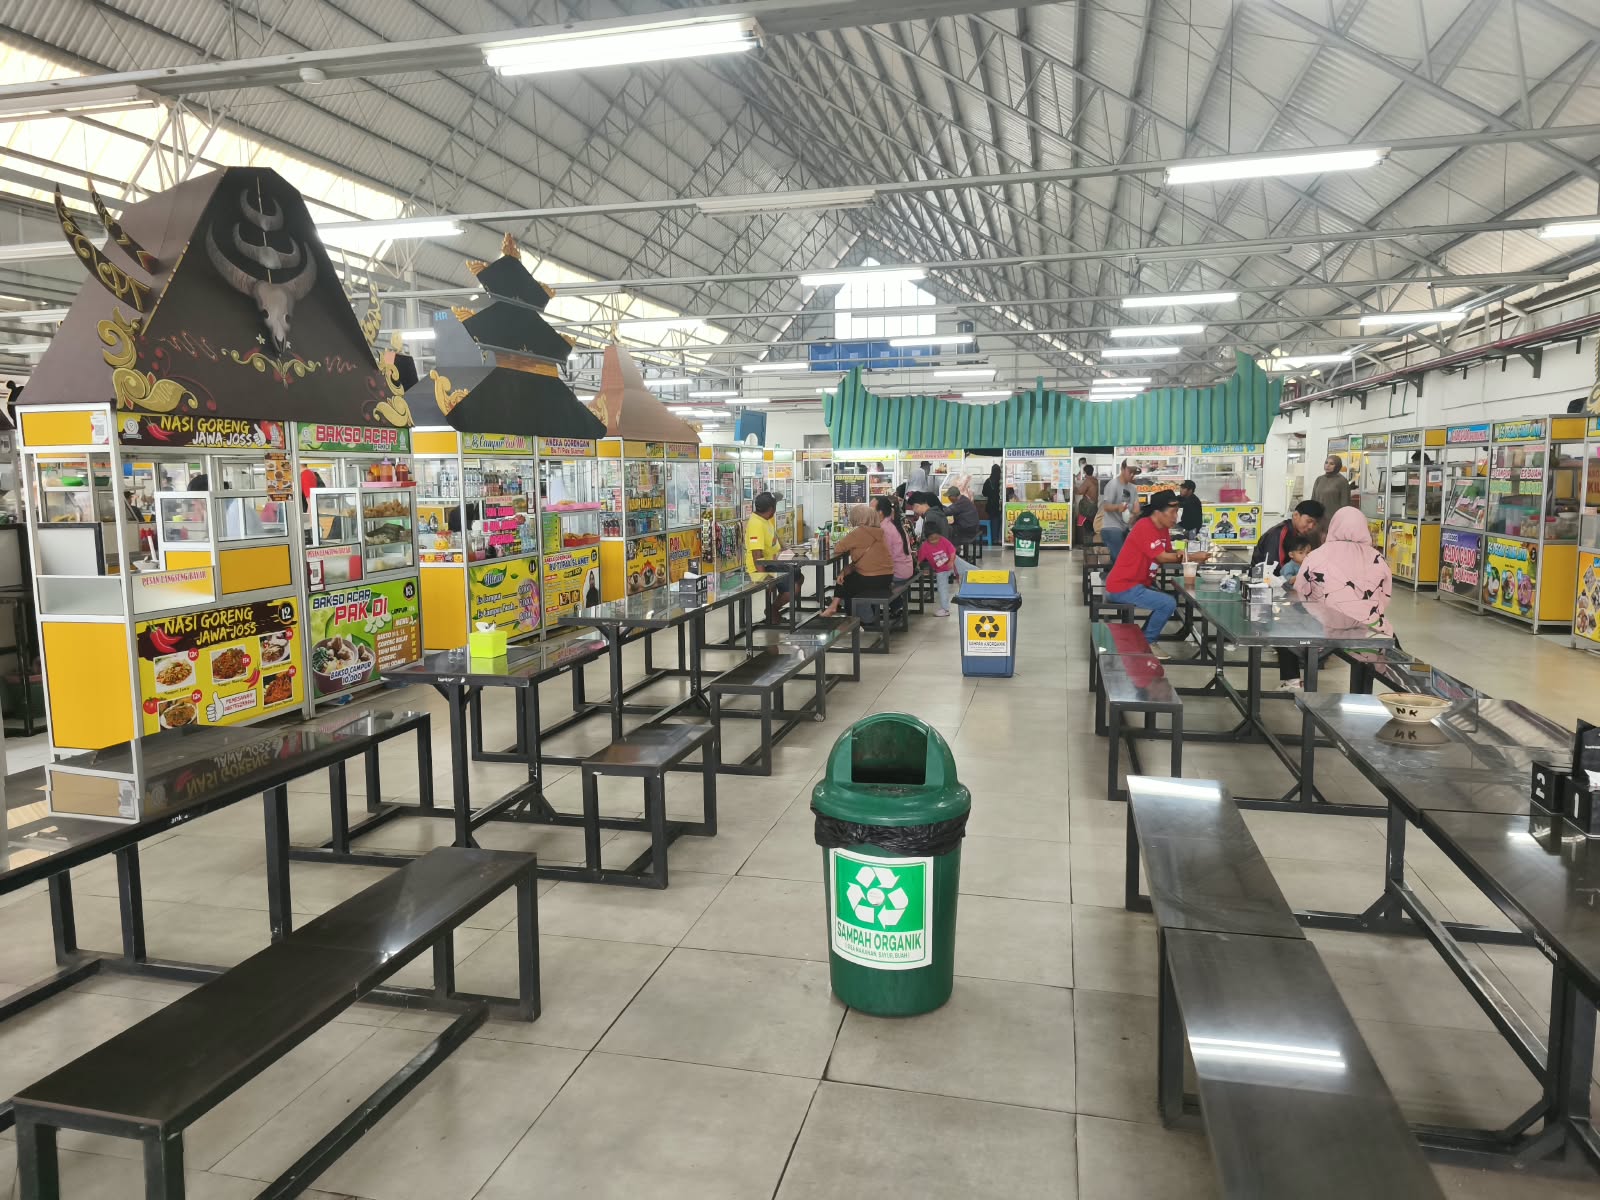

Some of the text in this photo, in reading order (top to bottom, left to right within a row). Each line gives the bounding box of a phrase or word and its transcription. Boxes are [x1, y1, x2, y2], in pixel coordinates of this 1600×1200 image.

[160, 416, 250, 434] NASI GORENG
[316, 425, 398, 445] BAKSO ACAR
[546, 439, 563, 447] ANEKA
[313, 590, 371, 609] BAKSO ACAR
[164, 607, 254, 636] NASI GORENG
[281, 606, 291, 620] 12
[334, 598, 388, 626] PAK DI
[196, 622, 257, 646] JAWA-JOSS
[330, 662, 372, 680] BAKSO CAMPUR
[838, 920, 922, 951] SAMPAH ORGANIK
